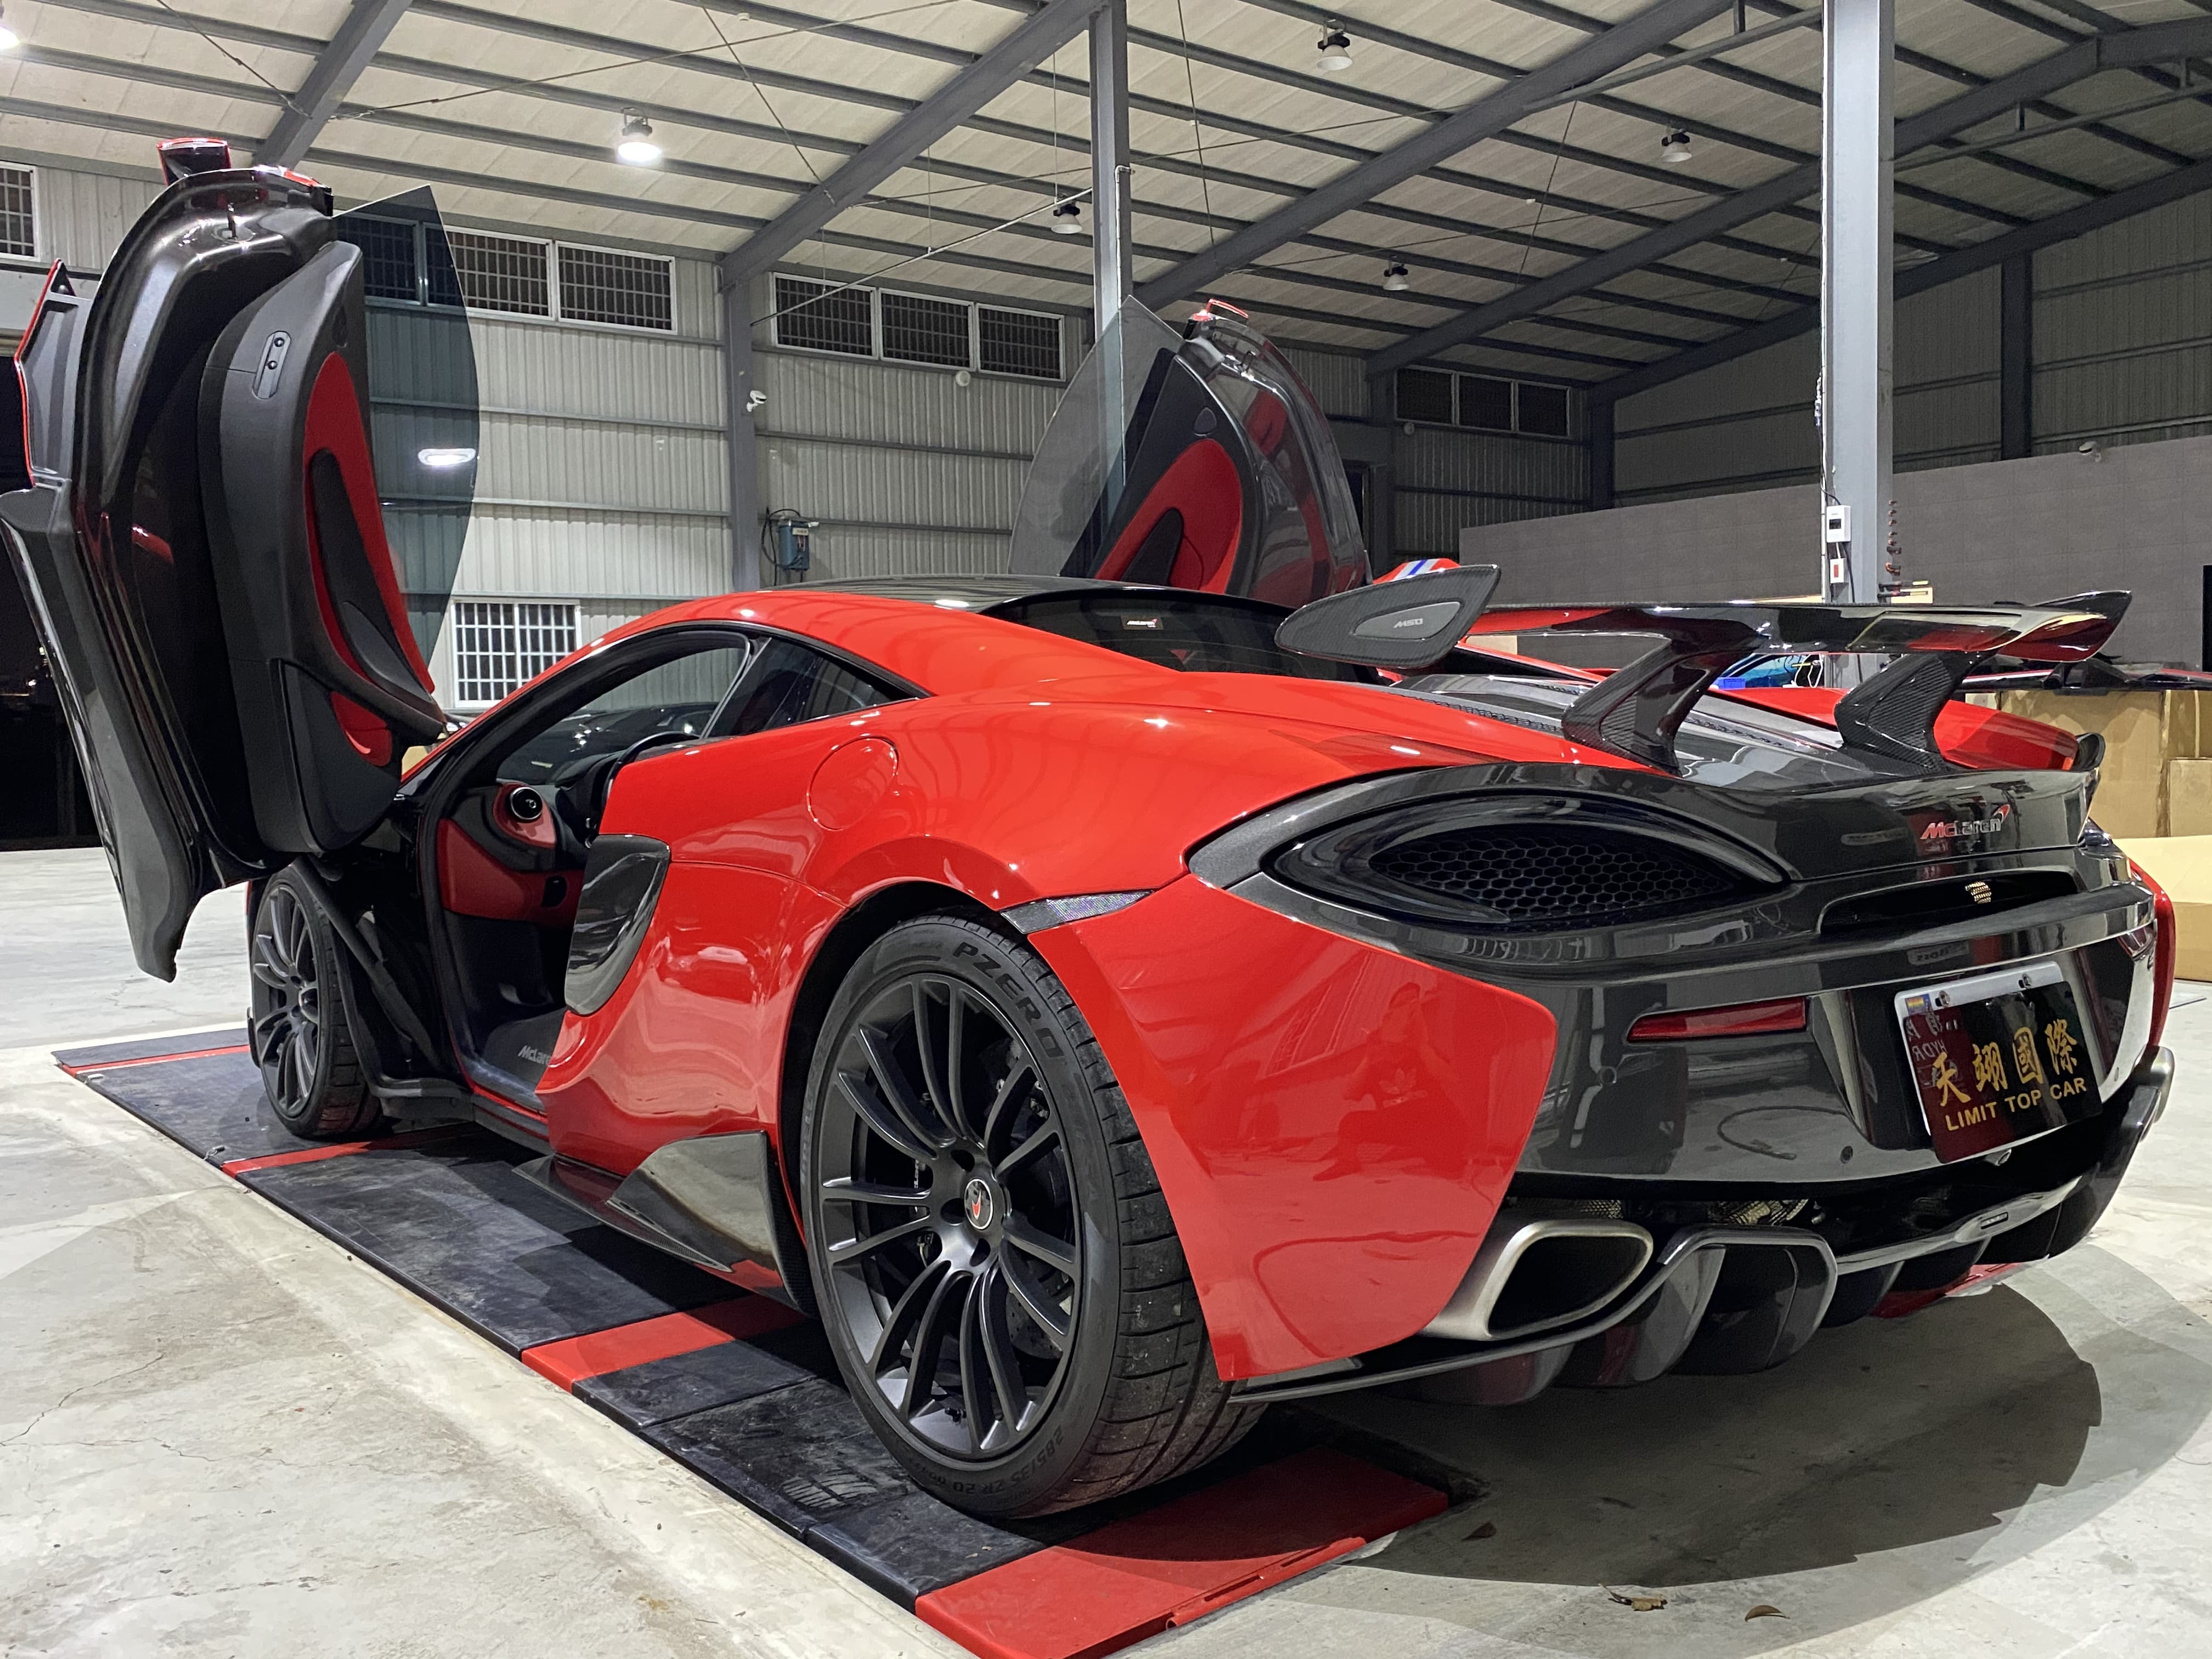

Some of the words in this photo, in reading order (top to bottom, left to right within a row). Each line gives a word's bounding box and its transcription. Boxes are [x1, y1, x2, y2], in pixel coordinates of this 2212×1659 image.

[1920, 818, 2001, 840] McLaren
[517, 1045, 551, 1065] McLare
[1945, 1102, 1997, 1131] LIMIT
[2005, 1090, 2041, 1113] TOP
[2050, 1077, 2086, 1099] CAR
